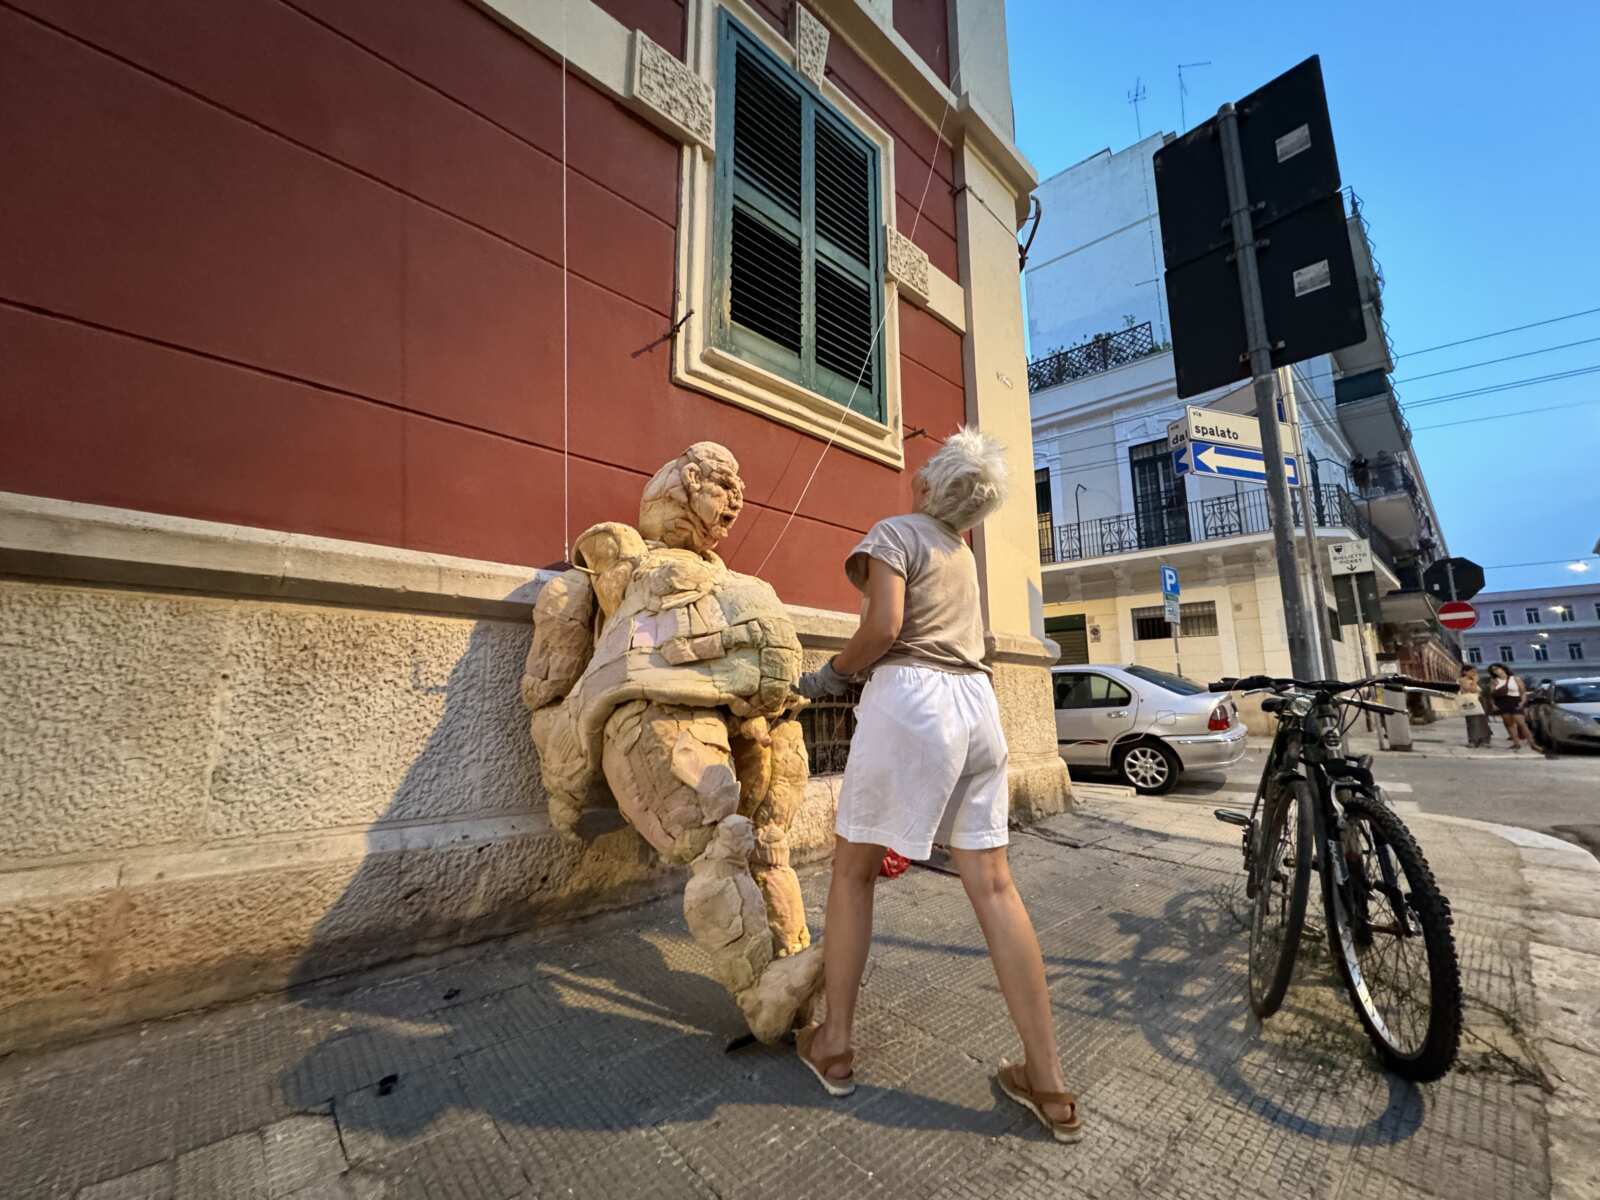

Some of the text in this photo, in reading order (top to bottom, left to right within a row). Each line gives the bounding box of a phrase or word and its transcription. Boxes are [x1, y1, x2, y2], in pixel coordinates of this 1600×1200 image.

[1172, 429, 1188, 445] dal
[1194, 425, 1239, 440] spalato
[1165, 569, 1176, 591] P
